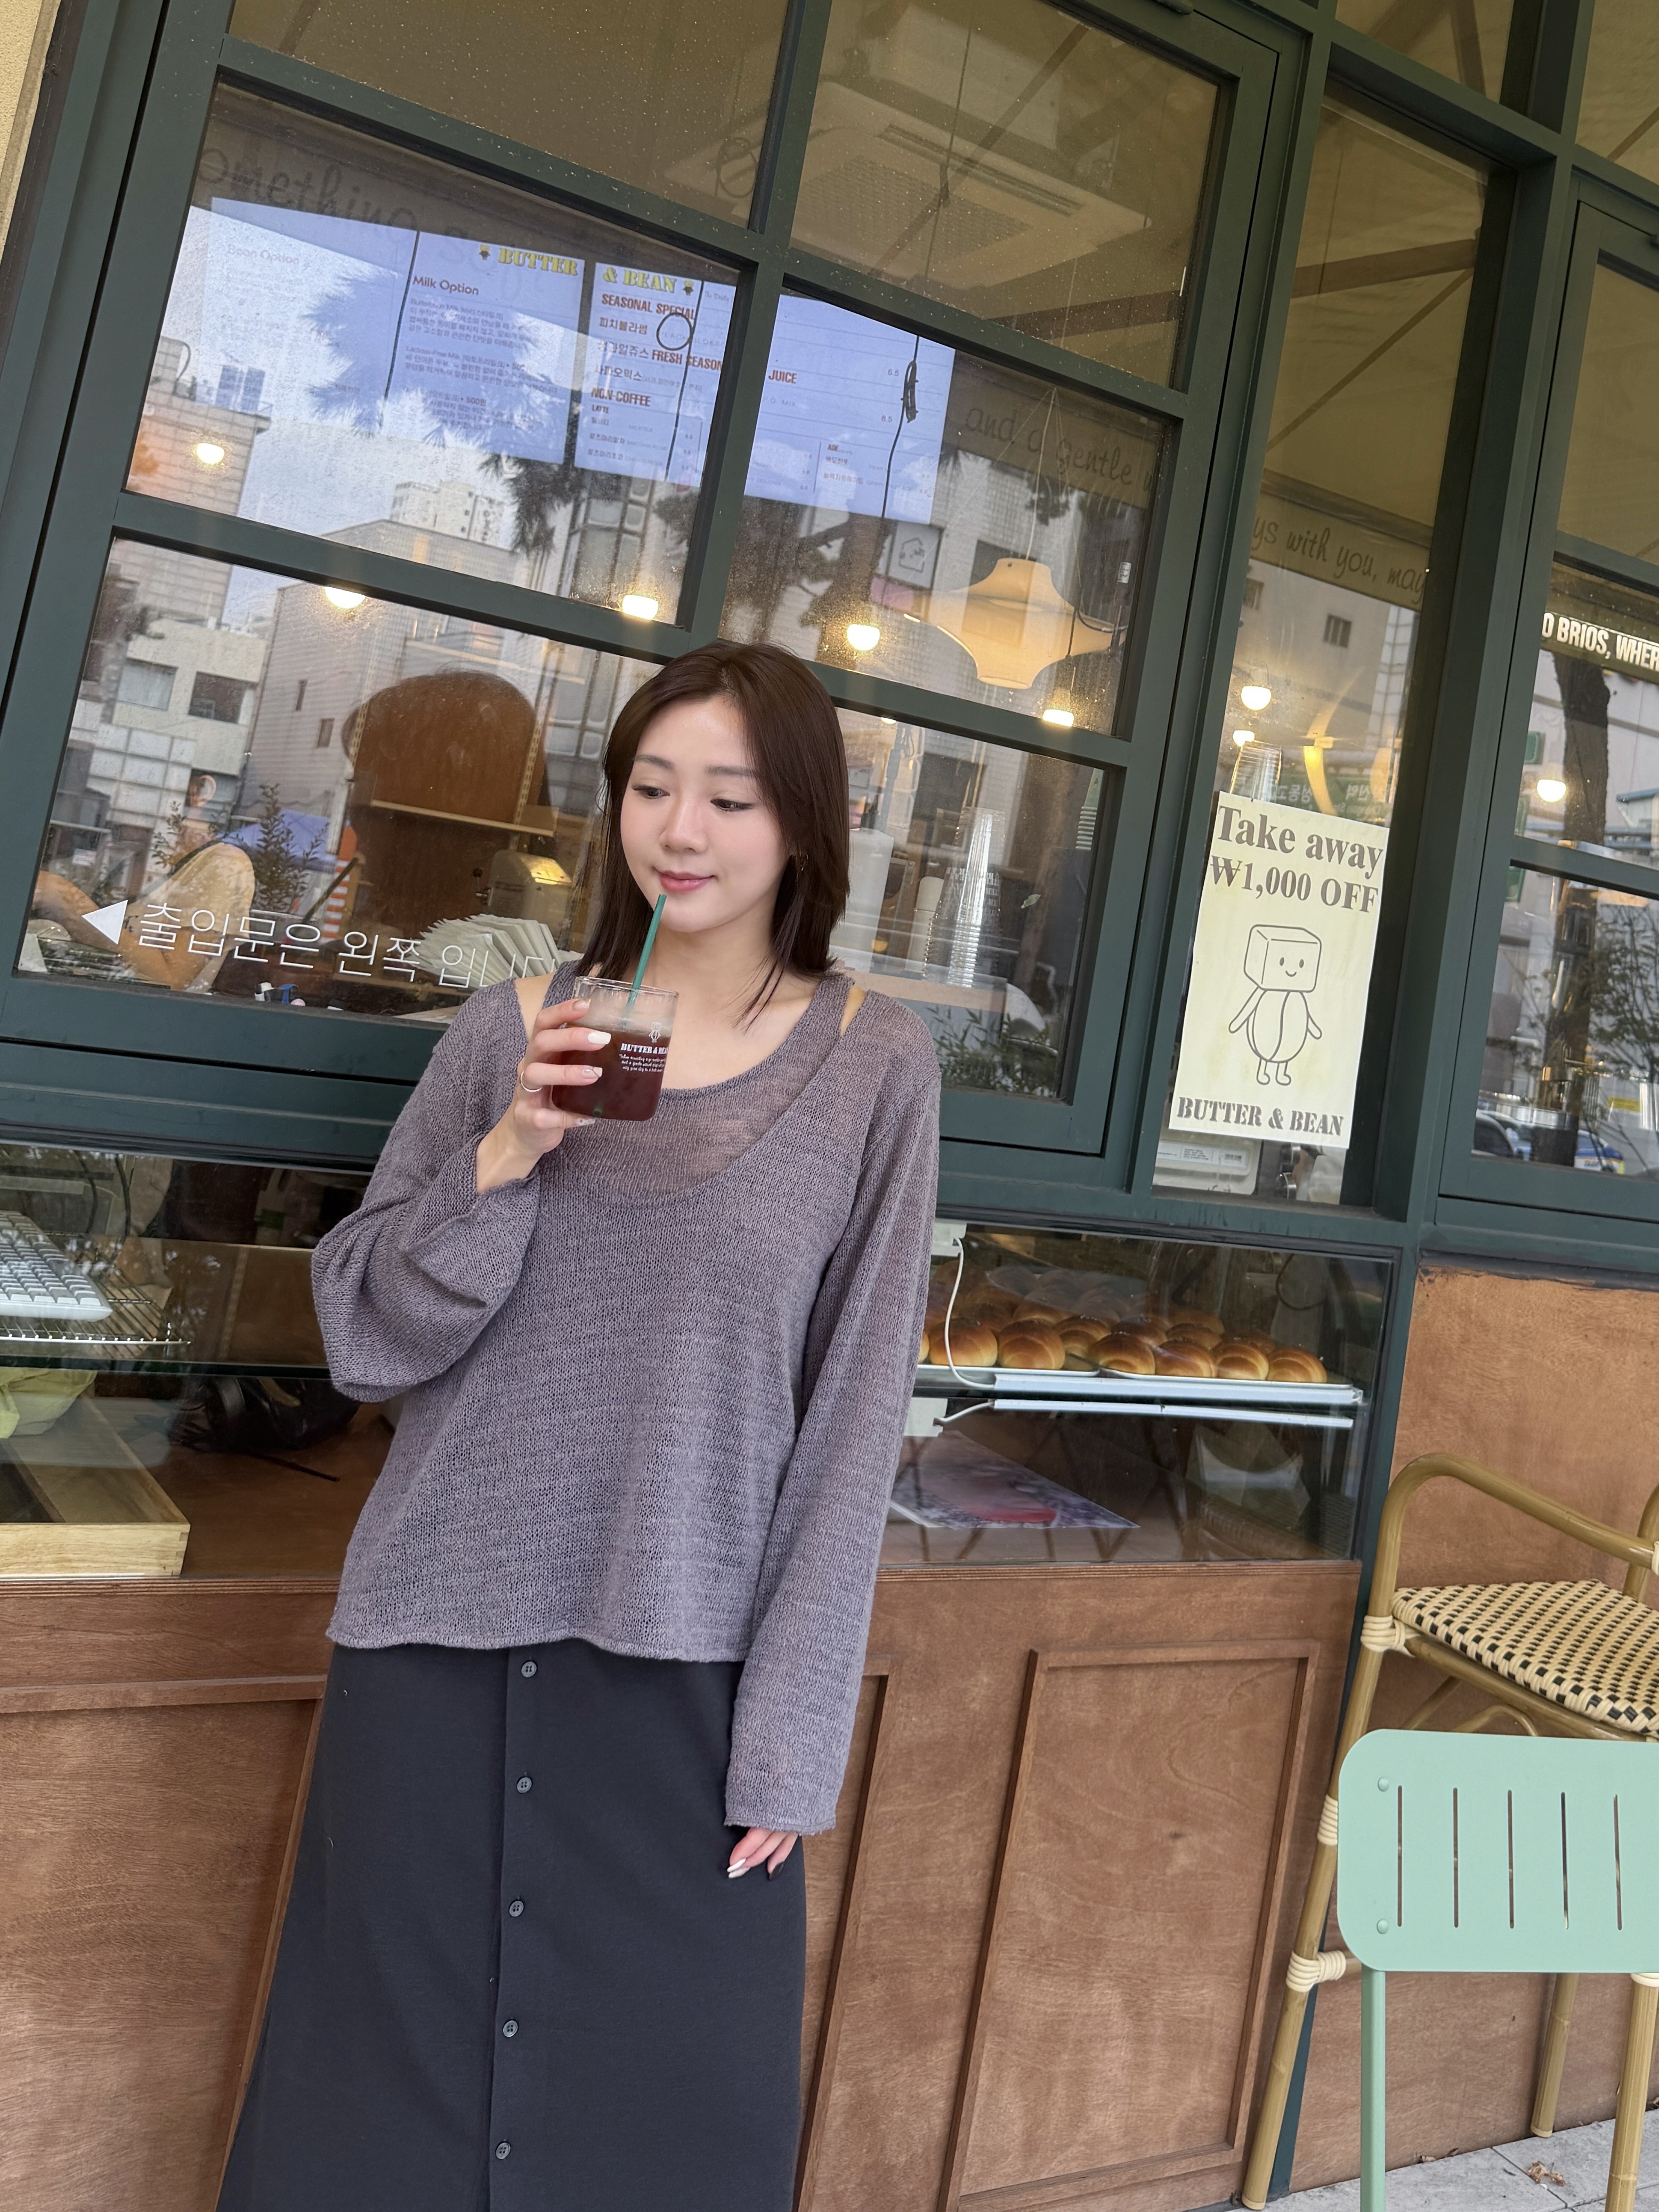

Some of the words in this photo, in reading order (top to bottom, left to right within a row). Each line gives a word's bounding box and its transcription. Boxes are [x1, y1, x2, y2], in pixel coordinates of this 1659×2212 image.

[413, 276, 436, 289] Milk
[439, 279, 479, 296] Option
[498, 247, 578, 277] BUTTER
[603, 267, 618, 283] &
[623, 270, 676, 293] BEAN
[602, 294, 652, 313] SEASONAL
[656, 303, 695, 320] SPECIAL
[652, 349, 683, 364] FRESH
[768, 370, 797, 384] JUICE
[887, 368, 899, 377] 6.5
[590, 387, 651, 408] NON-COFFEE
[881, 414, 893, 423] 8.5
[1056, 439, 1132, 485] gentle
[1286, 528, 1330, 562] with
[1334, 546, 1376, 582] you,
[1388, 567, 1425, 604] may
[1557, 617, 1611, 659] BRIOS,
[1218, 805, 1295, 854] Take
[1305, 834, 1383, 880] away
[1321, 878, 1379, 913] OFF
[139, 903, 321, 969] 출입문은
[338, 931, 422, 982] 왼쪽
[620, 1043, 652, 1054] BUTTER
[1177, 1097, 1262, 1127] BUTTER
[1268, 1107, 1283, 1130] &
[1289, 1110, 1344, 1136] BEAN
